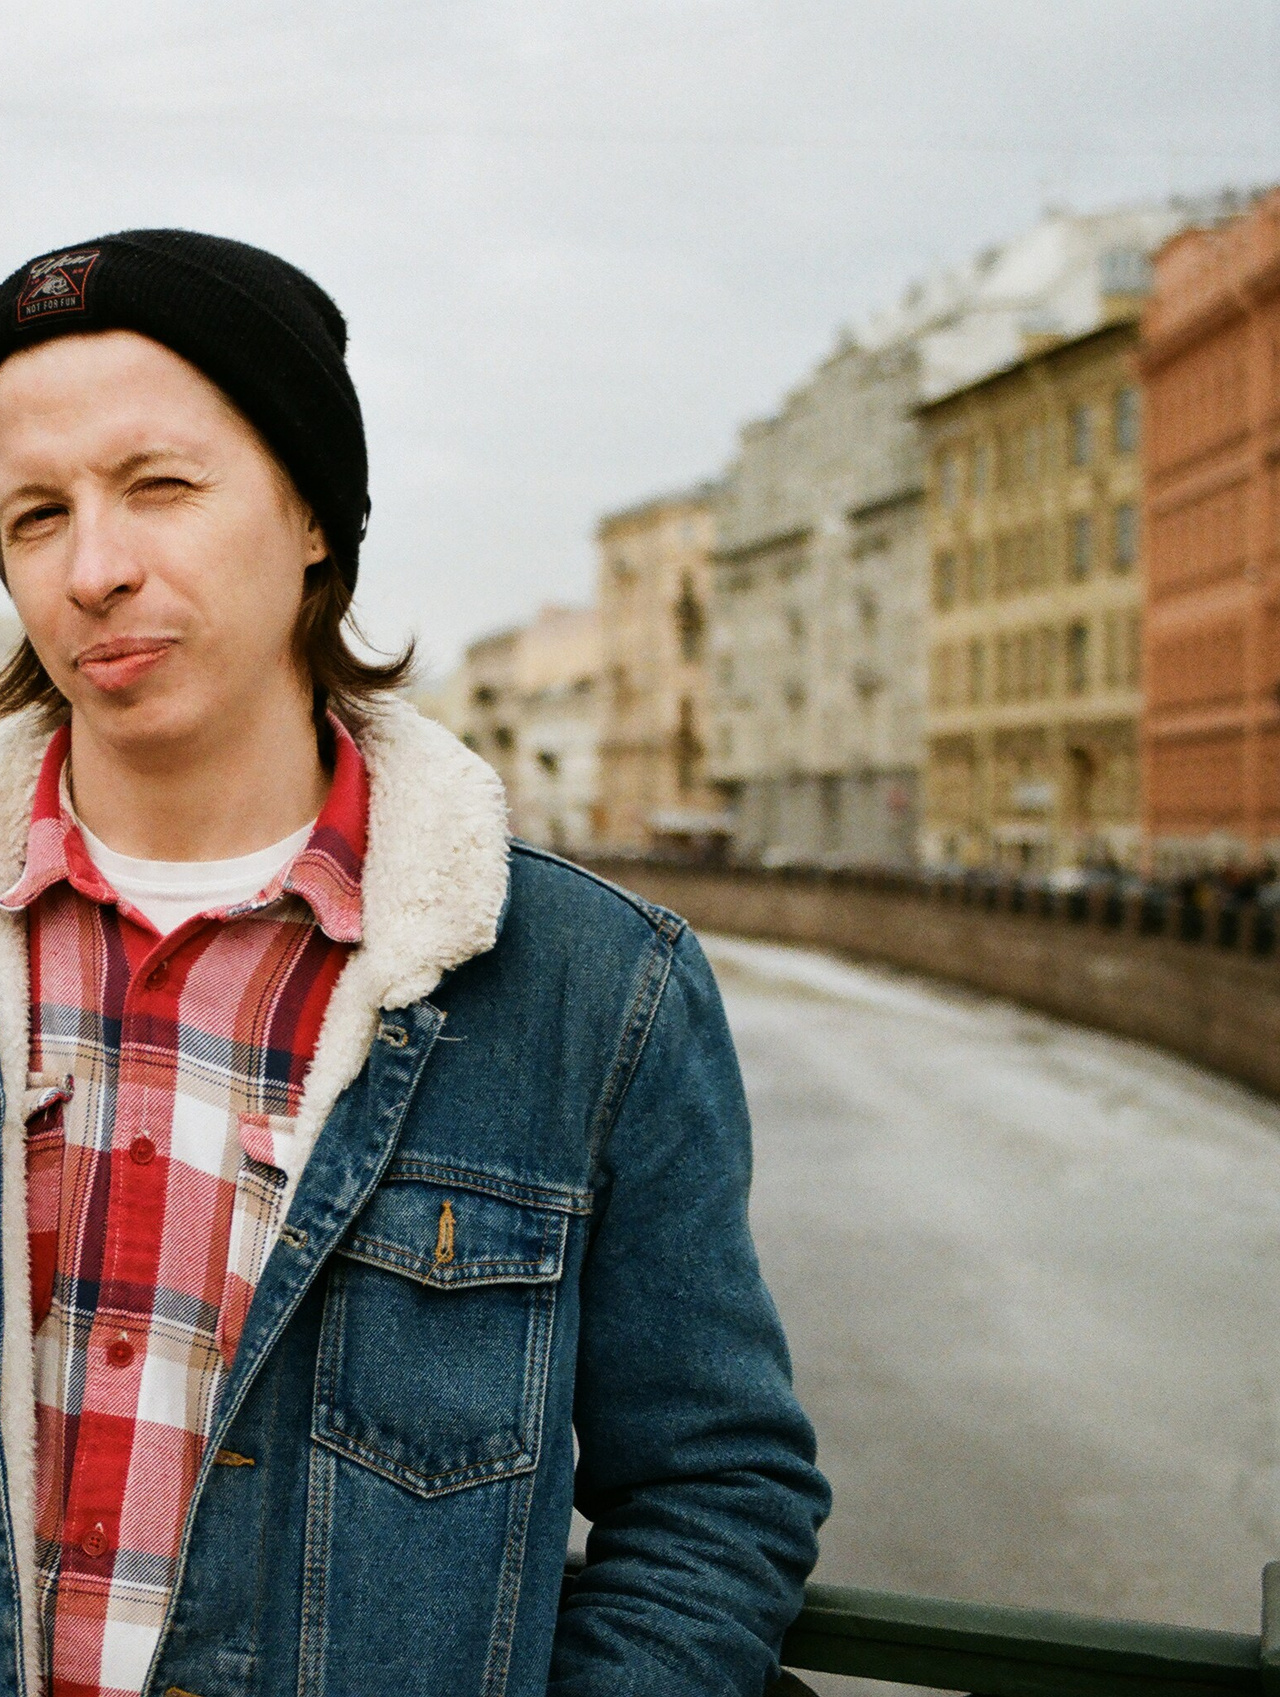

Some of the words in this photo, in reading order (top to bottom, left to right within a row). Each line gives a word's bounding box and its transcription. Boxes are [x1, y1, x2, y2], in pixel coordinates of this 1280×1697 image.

[26, 303, 40, 314] NOT
[43, 299, 58, 310] FOR
[60, 297, 76, 307] FUN
